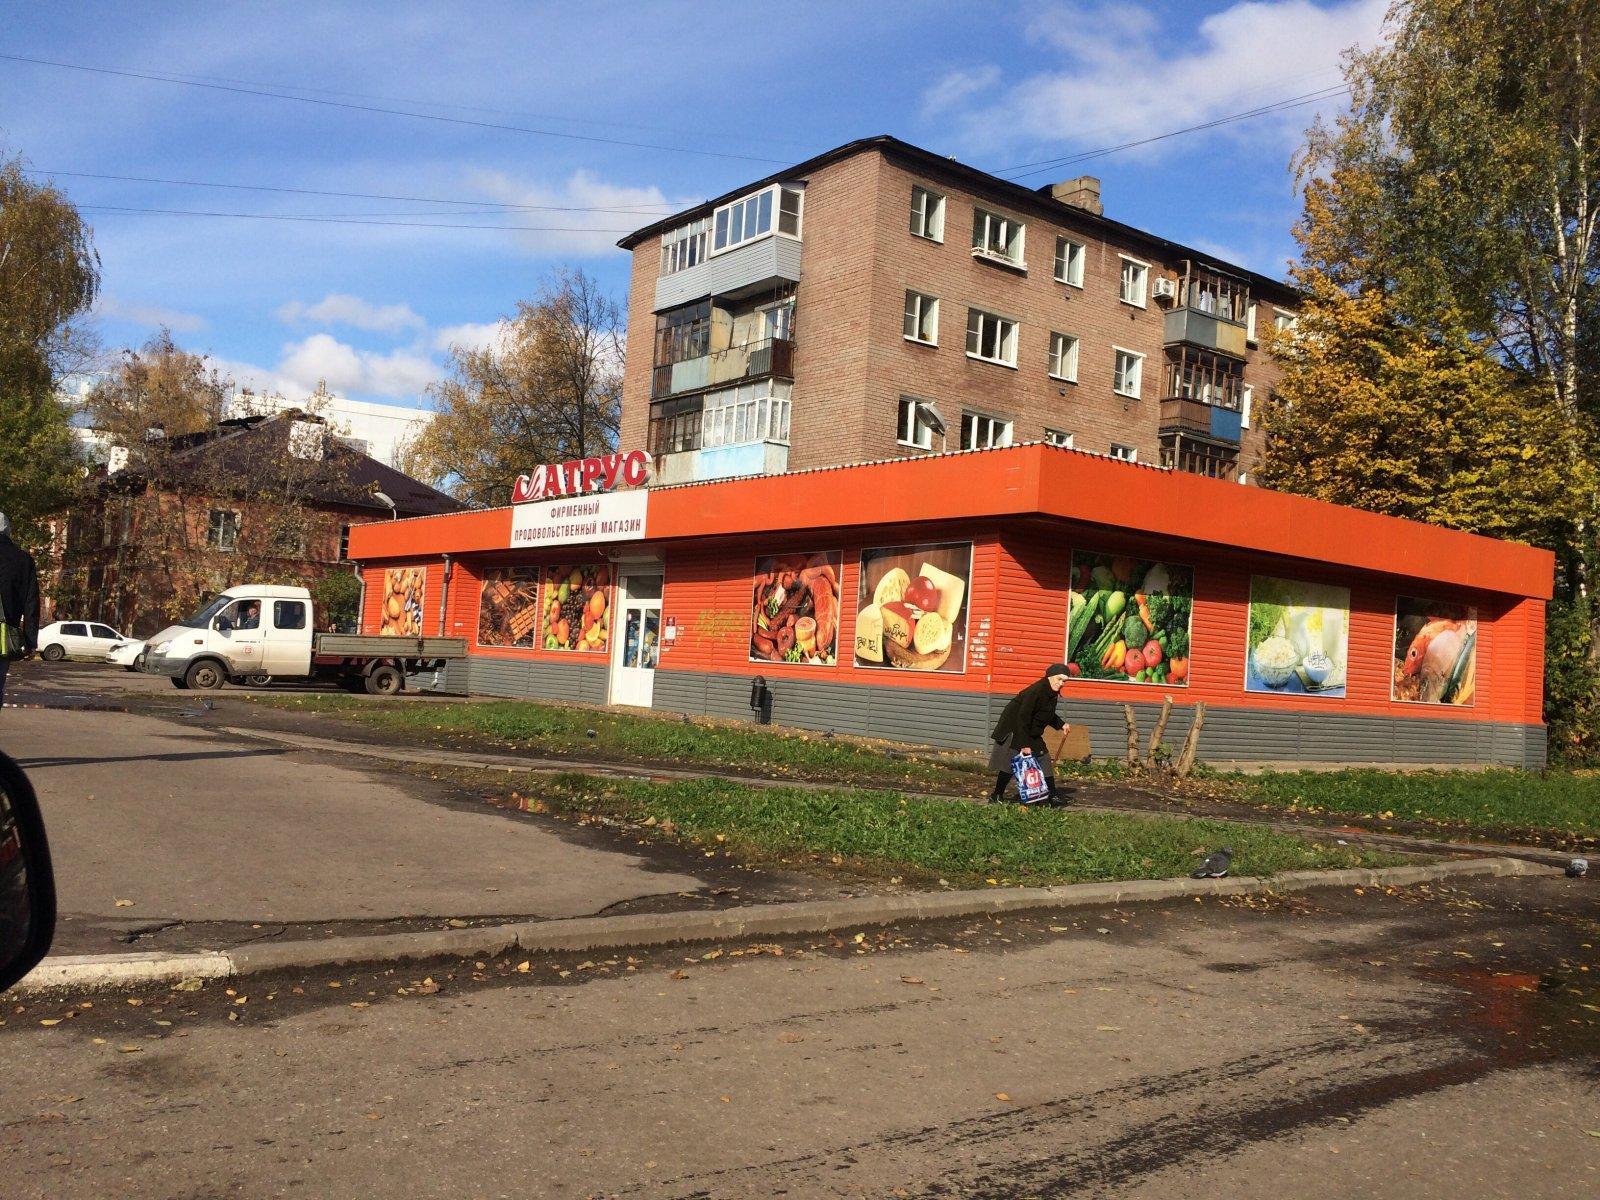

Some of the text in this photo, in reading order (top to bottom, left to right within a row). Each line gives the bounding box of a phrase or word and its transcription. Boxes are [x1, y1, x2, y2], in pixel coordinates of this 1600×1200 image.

[550, 499, 600, 519] ФИРМЕННЫЙ
[514, 518, 641, 541] ПРОДОВОЛЬСТВЕННЫЙ МАГАЗИН
